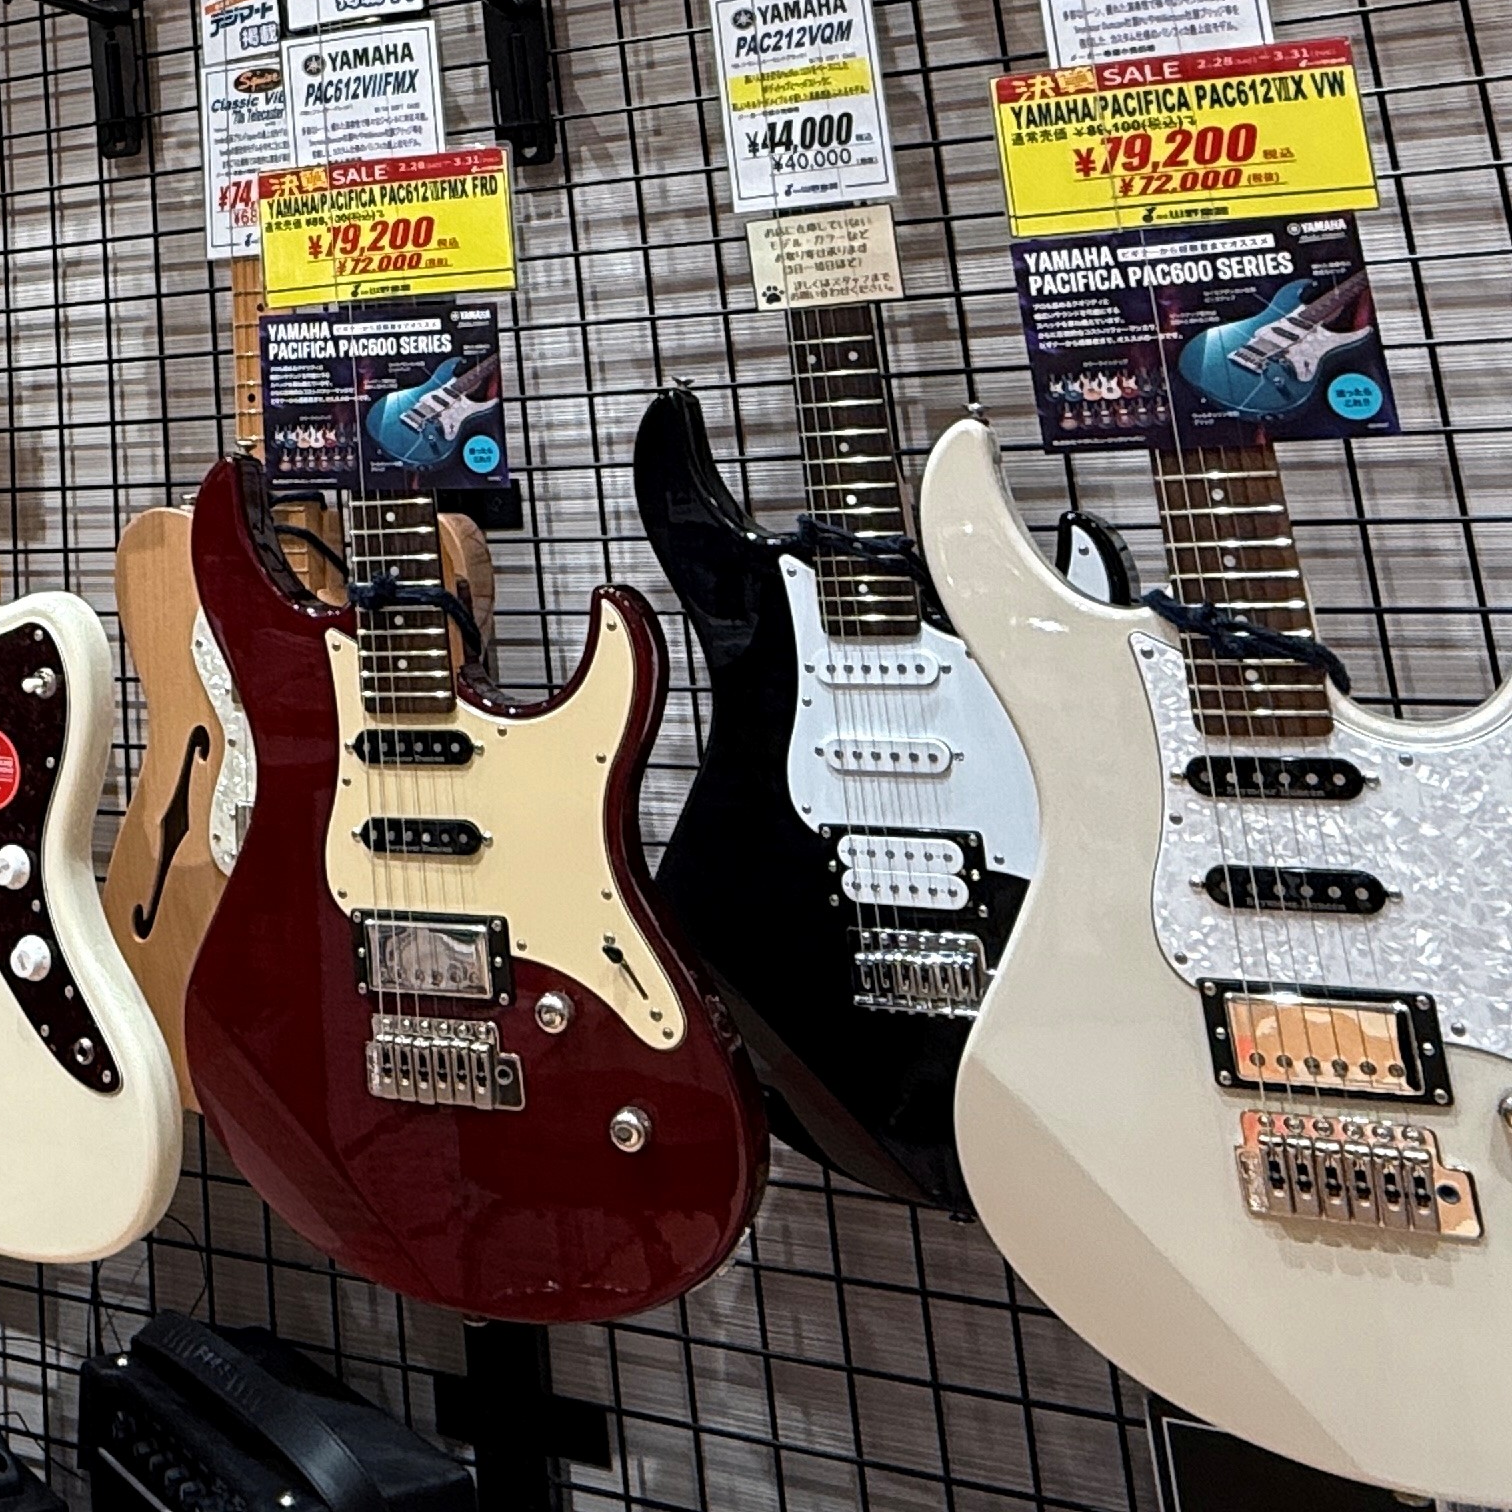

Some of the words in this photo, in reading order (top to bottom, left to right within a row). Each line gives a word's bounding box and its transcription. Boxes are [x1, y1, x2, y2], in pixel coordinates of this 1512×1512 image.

[209, 2, 274, 39] デジマート
[734, 19, 854, 59] PAC212VQM
[326, 42, 415, 74] YAMAHA
[304, 68, 420, 108] PAC612VIIFMX
[1102, 60, 1182, 87] SALE
[1310, 70, 1346, 100] VW
[211, 94, 259, 114] Classic
[746, 112, 854, 158] ¥44,000
[772, 147, 852, 173] ¥40,000
[1072, 122, 1258, 178] ¥79,200
[332, 163, 388, 186] SALE
[472, 174, 498, 199] FRD
[1118, 167, 1244, 198] ¥72,000
[308, 215, 436, 261] ¥79,200
[1301, 219, 1348, 234] YAMAHA
[337, 252, 422, 276] ¥72,000
[1023, 245, 1116, 274] YAMAHA
[1028, 268, 1126, 297] PACIFICA
[1127, 259, 1214, 288] PAC600
[1216, 251, 1295, 280] SERIES
[267, 320, 331, 343] YAMAHA
[268, 340, 337, 362] PACIFICA
[338, 336, 399, 359] PAC600
[400, 333, 453, 355] SERIES
